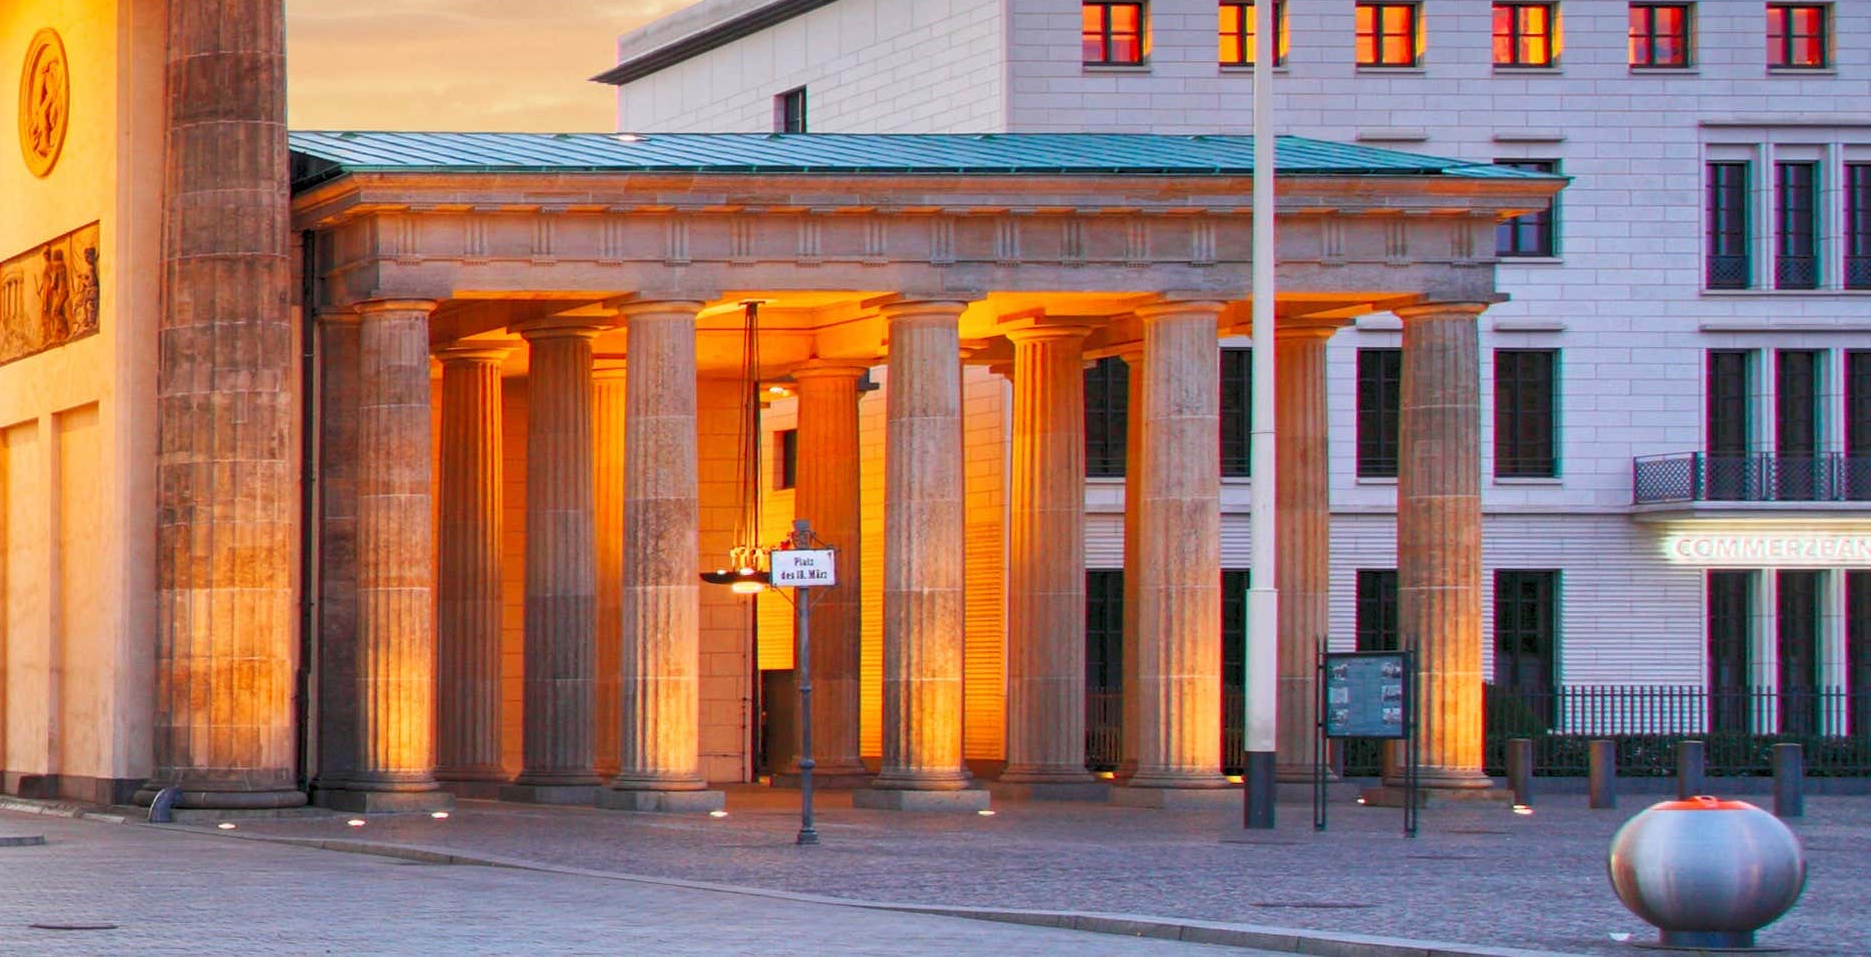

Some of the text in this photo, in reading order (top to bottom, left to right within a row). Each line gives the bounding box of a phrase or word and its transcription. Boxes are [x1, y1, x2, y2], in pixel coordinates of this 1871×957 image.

[794, 557, 814, 566] Platz
[781, 569, 827, 579] des 18. März
